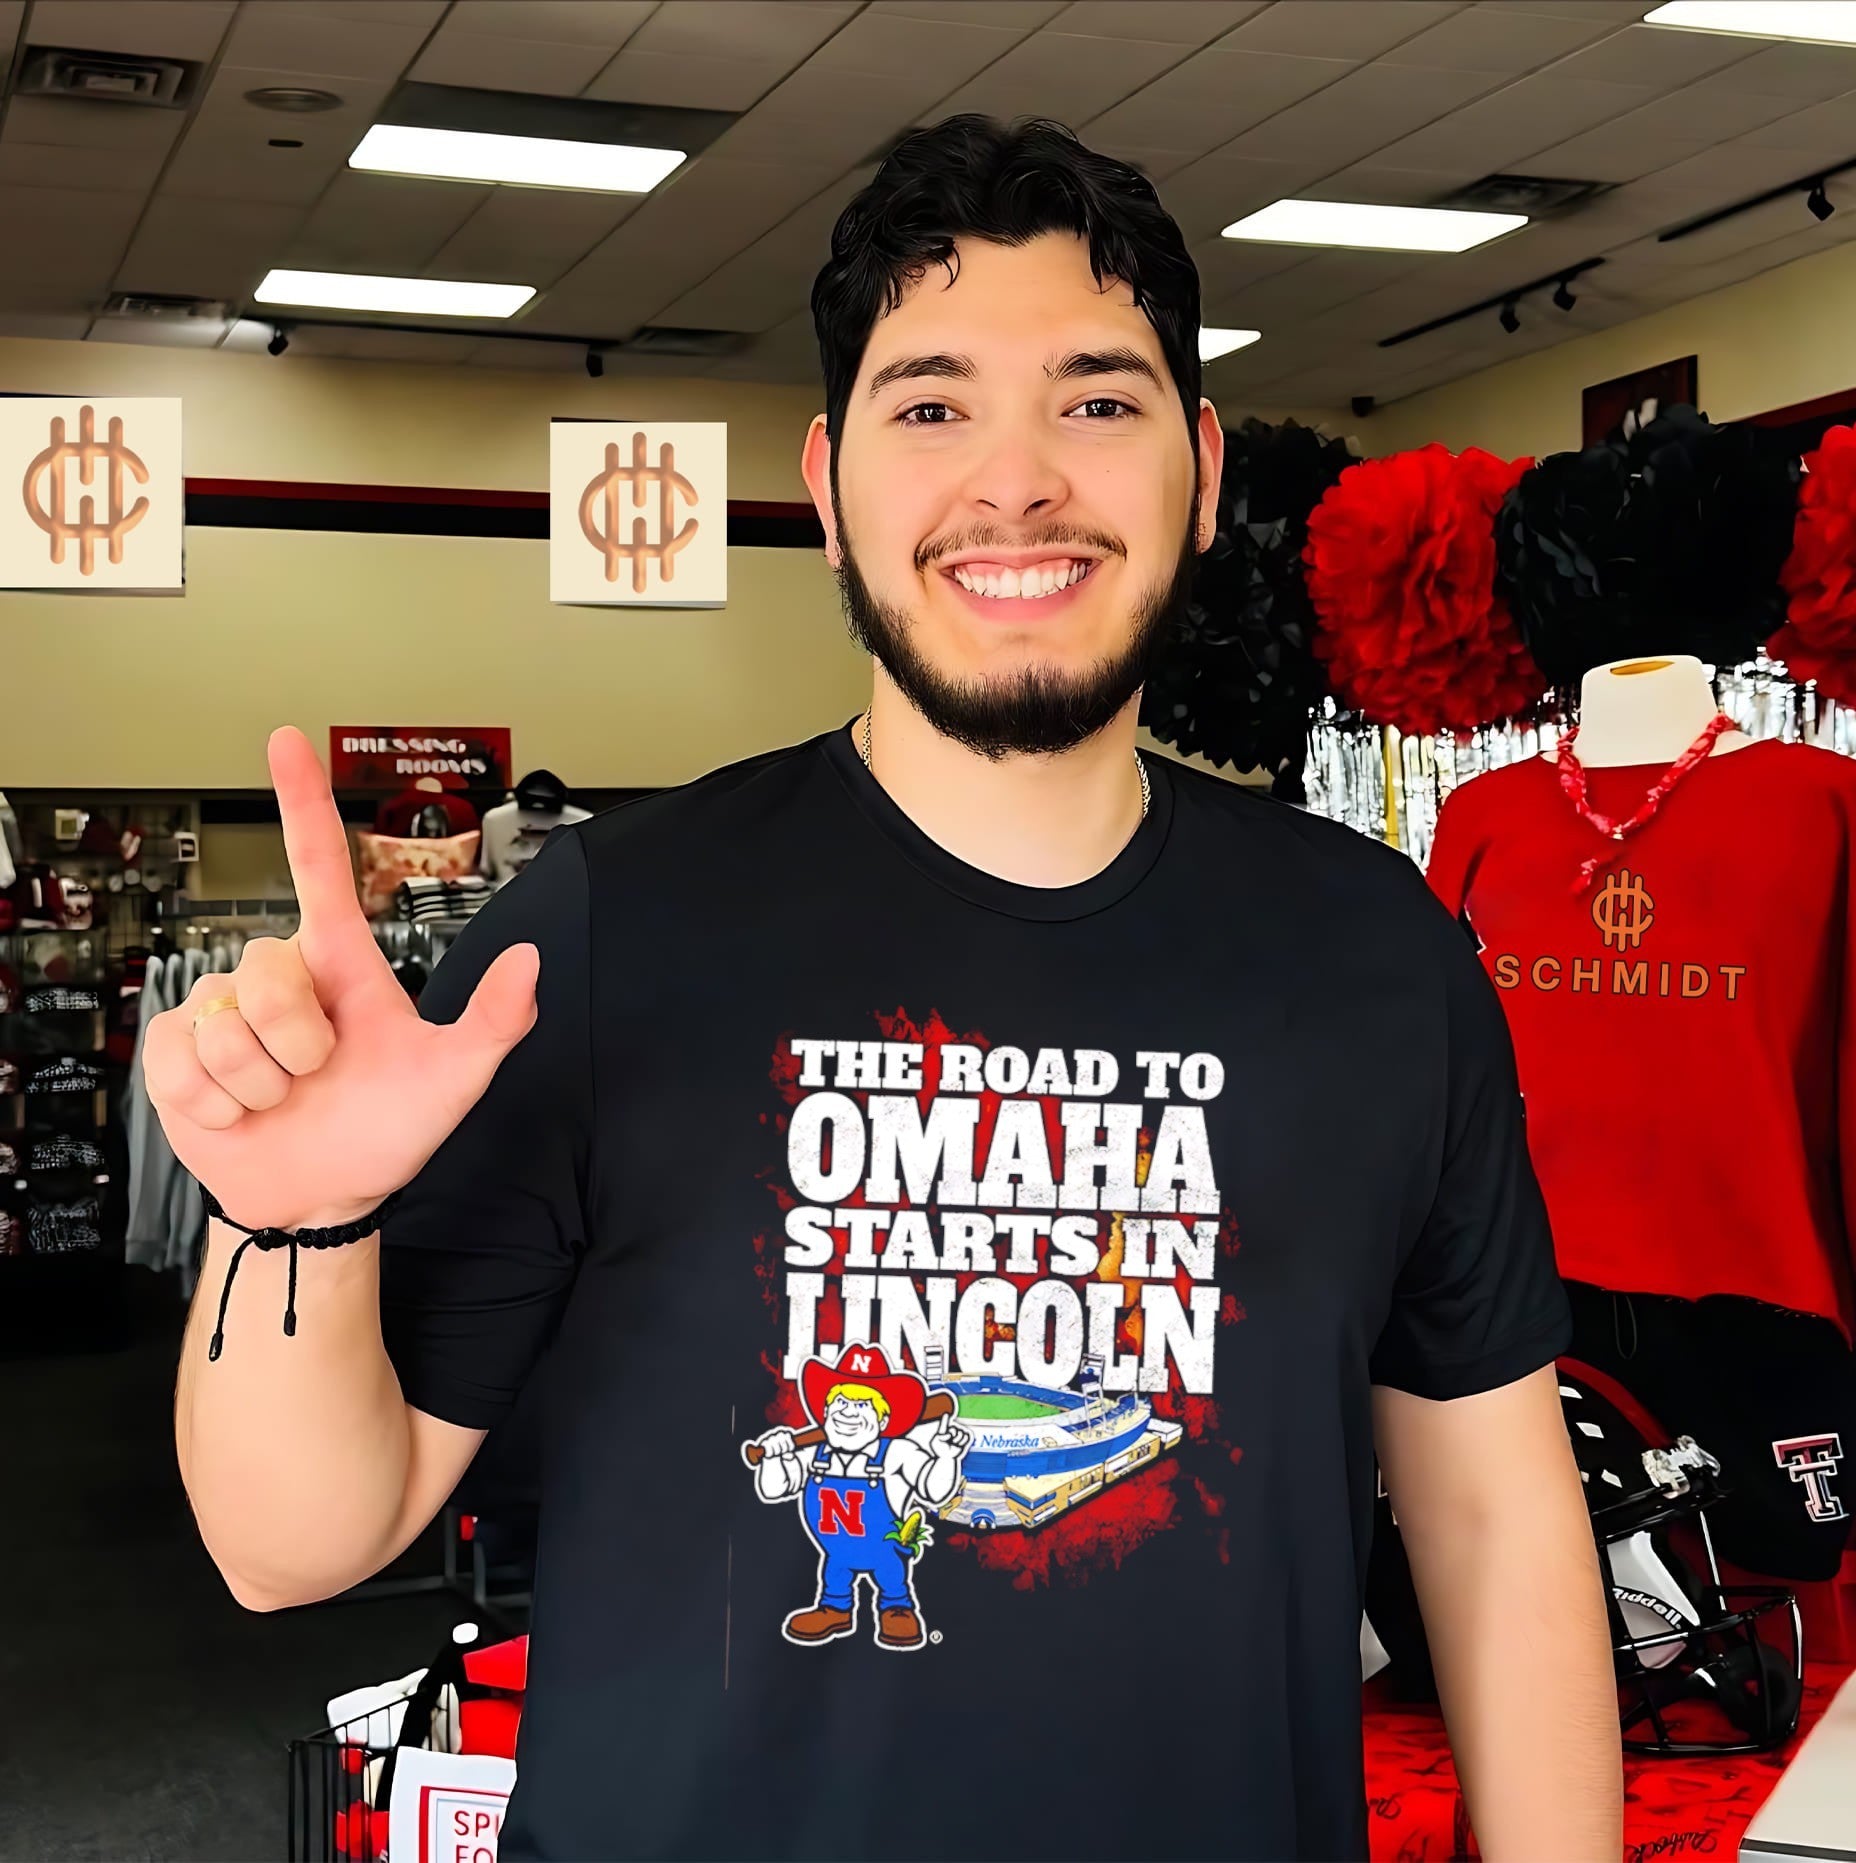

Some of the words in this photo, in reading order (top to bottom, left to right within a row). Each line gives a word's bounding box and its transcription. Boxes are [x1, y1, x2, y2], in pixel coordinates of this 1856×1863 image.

[395, 758, 487, 775] ROOMS
[1494, 954, 1747, 1000] SCHMIDT
[791, 1039, 923, 1091] THE
[939, 1044, 1120, 1097] ROAD
[1136, 1051, 1225, 1101] TO
[787, 1091, 1222, 1214] OMAHA
[784, 1206, 1100, 1277] STARTS
[1119, 1217, 1220, 1280] IN
[783, 1271, 1221, 1395] LINCOLN
[851, 1353, 872, 1374] N
[980, 1434, 1040, 1448] Nebraska
[818, 1487, 866, 1537] N
